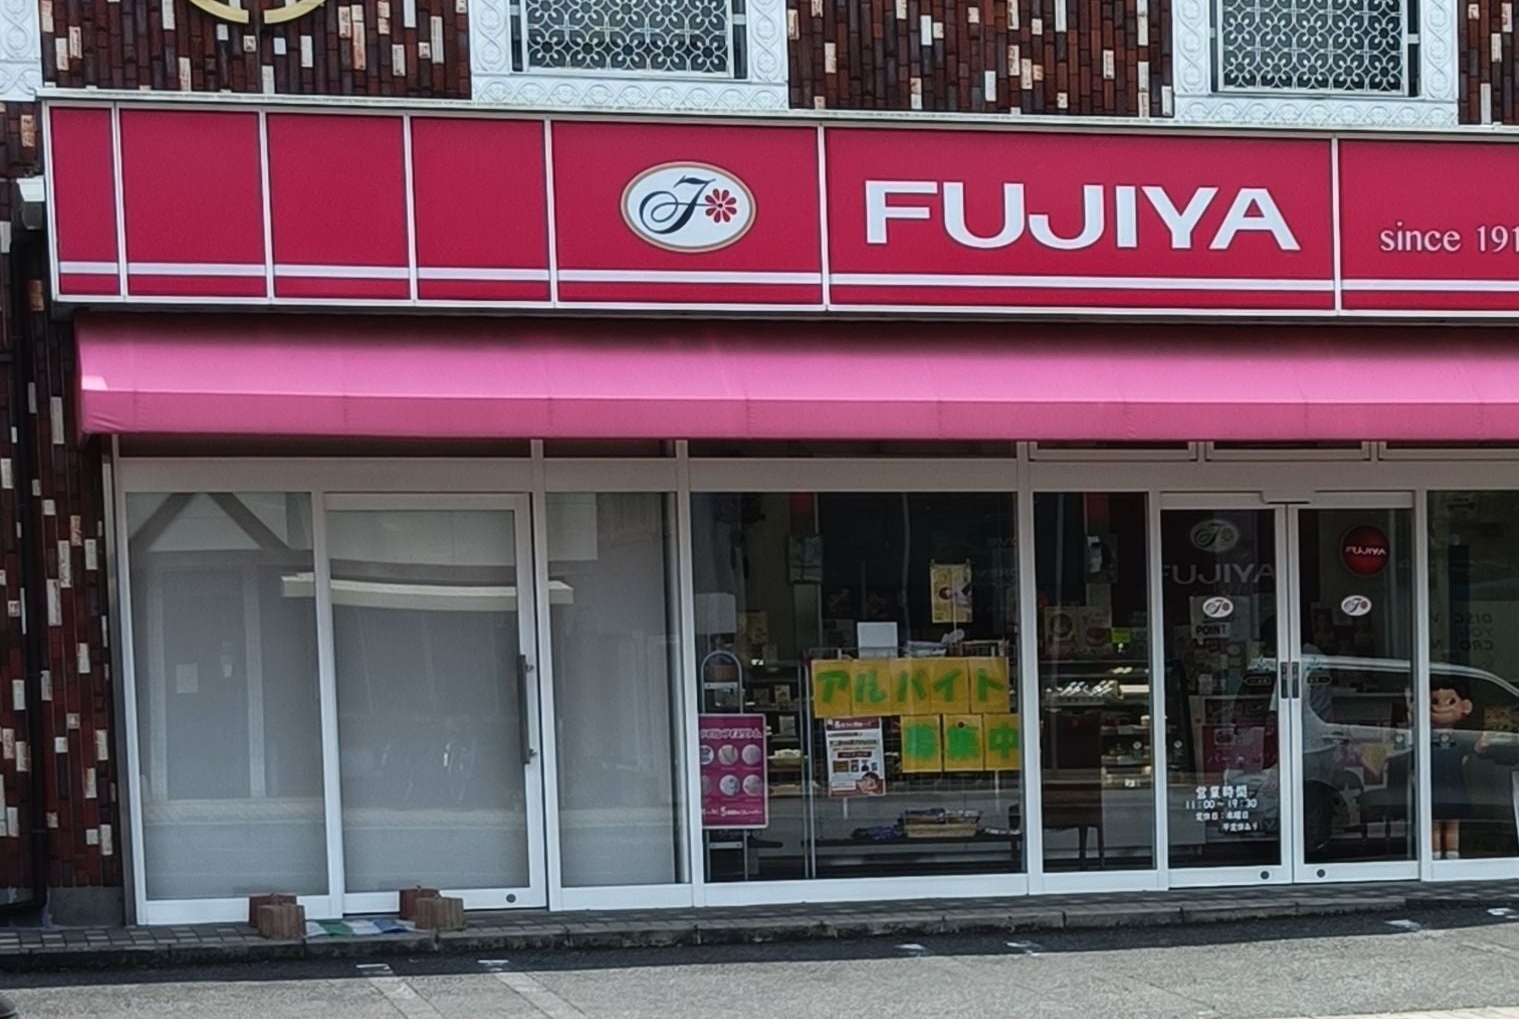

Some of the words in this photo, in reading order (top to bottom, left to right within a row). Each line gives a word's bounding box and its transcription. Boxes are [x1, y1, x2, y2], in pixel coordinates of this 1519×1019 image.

[865, 179, 1302, 251] FUJIYA
[1379, 221, 1461, 253] since
[1345, 545, 1388, 557] FUJIYA
[1195, 784, 1248, 799] 営業時間
